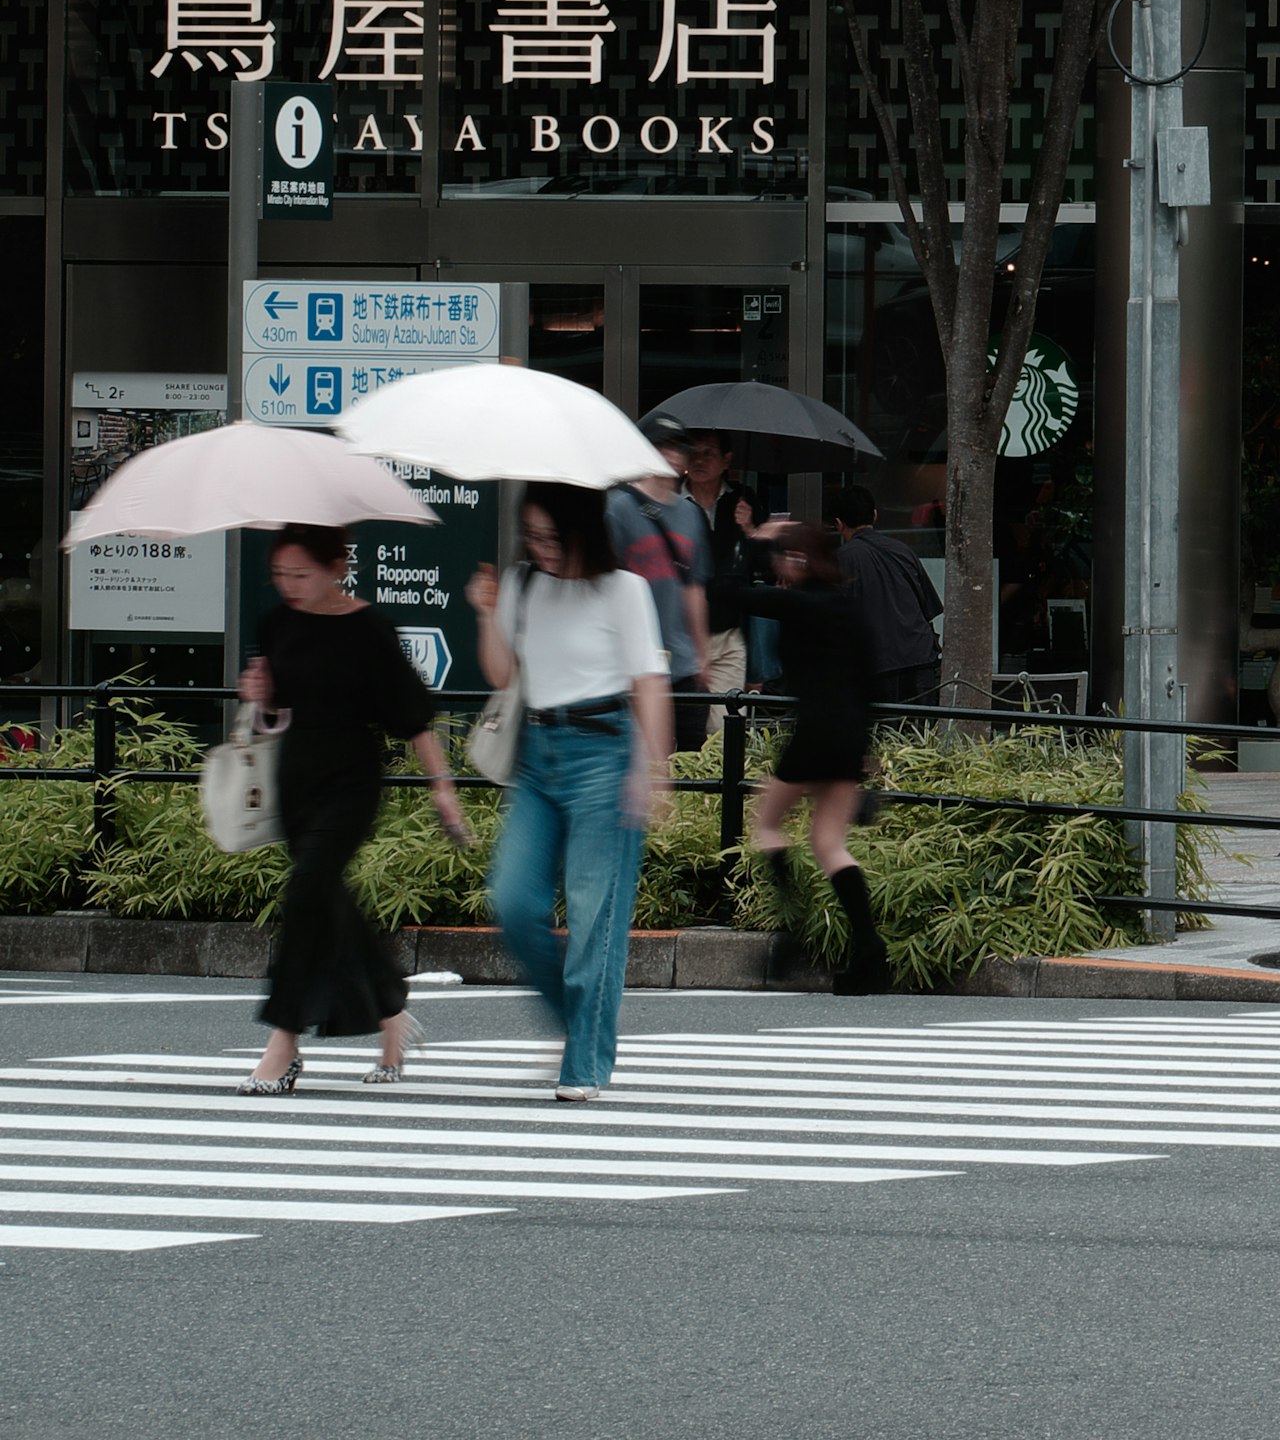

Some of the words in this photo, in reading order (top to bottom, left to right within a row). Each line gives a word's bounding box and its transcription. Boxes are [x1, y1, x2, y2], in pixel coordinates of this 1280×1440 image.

[531, 115, 775, 154] BOOKS
[352, 293, 479, 321] 地下鉄麻布十番駅
[262, 327, 298, 343] 430m
[352, 323, 391, 349] Subway
[394, 324, 457, 345] Azabu-Juban
[460, 324, 479, 345] Sta.
[109, 386, 125, 400] 2F
[165, 383, 190, 391] SHARE
[193, 384, 225, 392] LOUNGE
[261, 400, 297, 416] 510m
[454, 486, 479, 509] Map
[90, 543, 193, 560] ゆとりの188席。
[377, 545, 406, 562] 6-11
[377, 564, 440, 587] Roppongi
[377, 587, 421, 605] Minato
[424, 588, 449, 610] City
